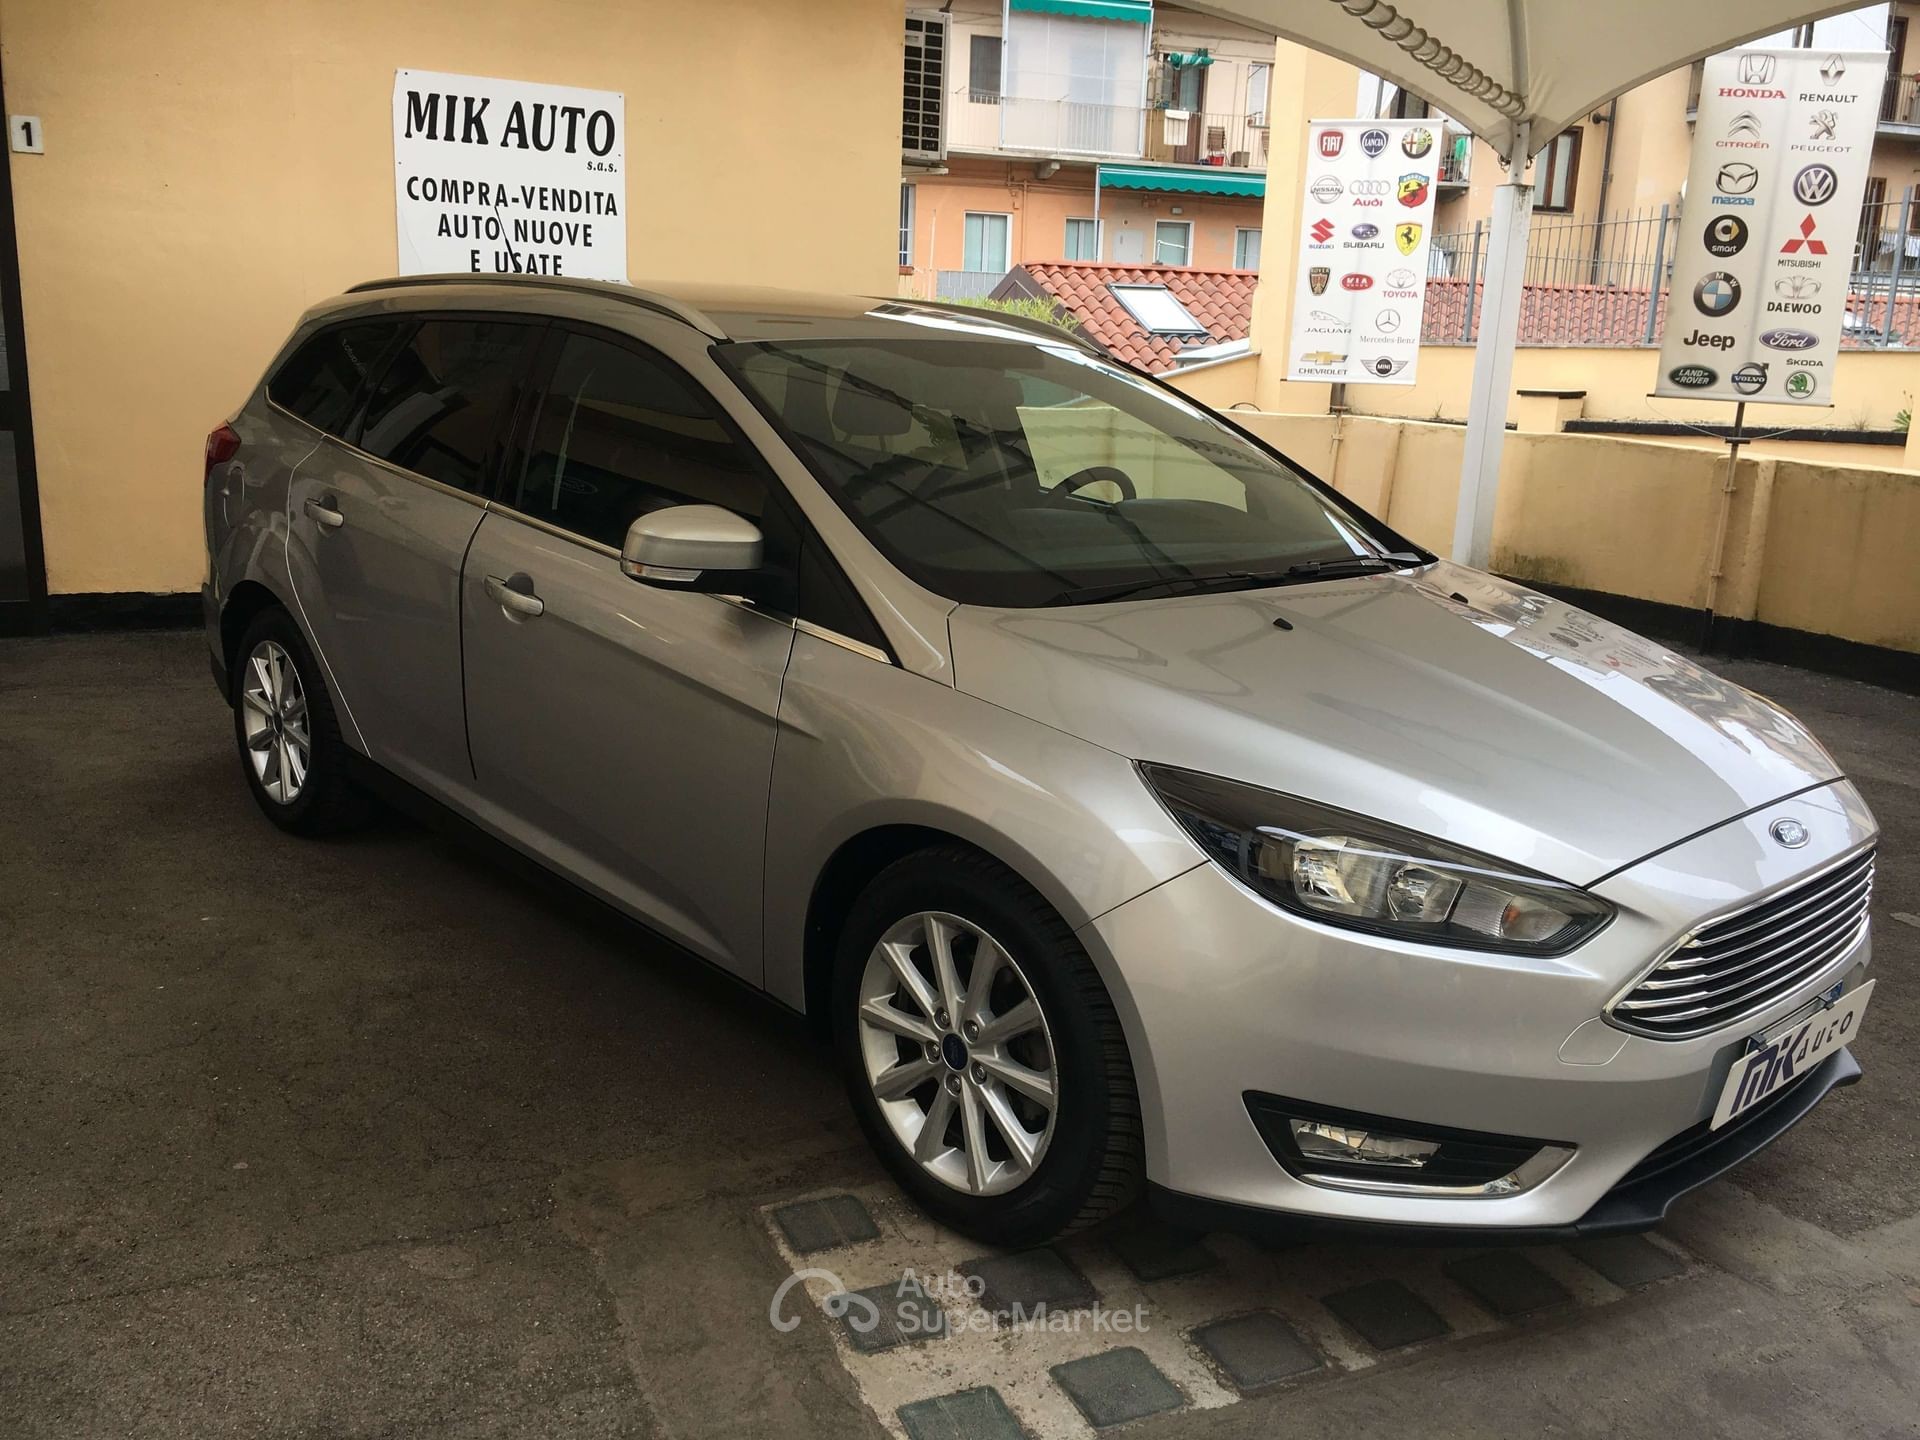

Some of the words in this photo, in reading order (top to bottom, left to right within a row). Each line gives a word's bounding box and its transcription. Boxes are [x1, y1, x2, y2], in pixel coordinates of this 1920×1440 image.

[1718, 87, 1786, 100] HONDA
[1799, 93, 1858, 104] RENAULT
[405, 90, 490, 145] MIK
[500, 100, 616, 157] AUTO
[21, 121, 33, 147] 1
[1322, 135, 1342, 152] FIAT
[1364, 137, 1384, 148] LANCIA
[1790, 144, 1853, 153] PEUGEOT
[586, 160, 618, 173] s.a.s.
[1312, 186, 1341, 194] NISSAN
[406, 175, 618, 217] COMPRA-VENDITA
[1711, 196, 1755, 206] mazda
[1352, 197, 1383, 207] Audi
[437, 213, 500, 241] AUTO
[514, 218, 593, 248] NUOVE
[1711, 244, 1737, 254] smart
[470, 249, 481, 273] E
[494, 251, 563, 277] USATE
[1777, 259, 1822, 269] MITSUBISHI
[1700, 272, 1738, 287] BMW
[1382, 290, 1418, 299] TOYOTA
[1767, 301, 1822, 315] DAEWOO
[1359, 335, 1416, 345] Mercedes-Benz
[1683, 329, 1736, 351] Jeep
[1770, 330, 1809, 348] Ford
[1298, 367, 1348, 376] CHEVROLET
[1680, 376, 1709, 385] ROVER
[1734, 375, 1765, 383] VOLVO
